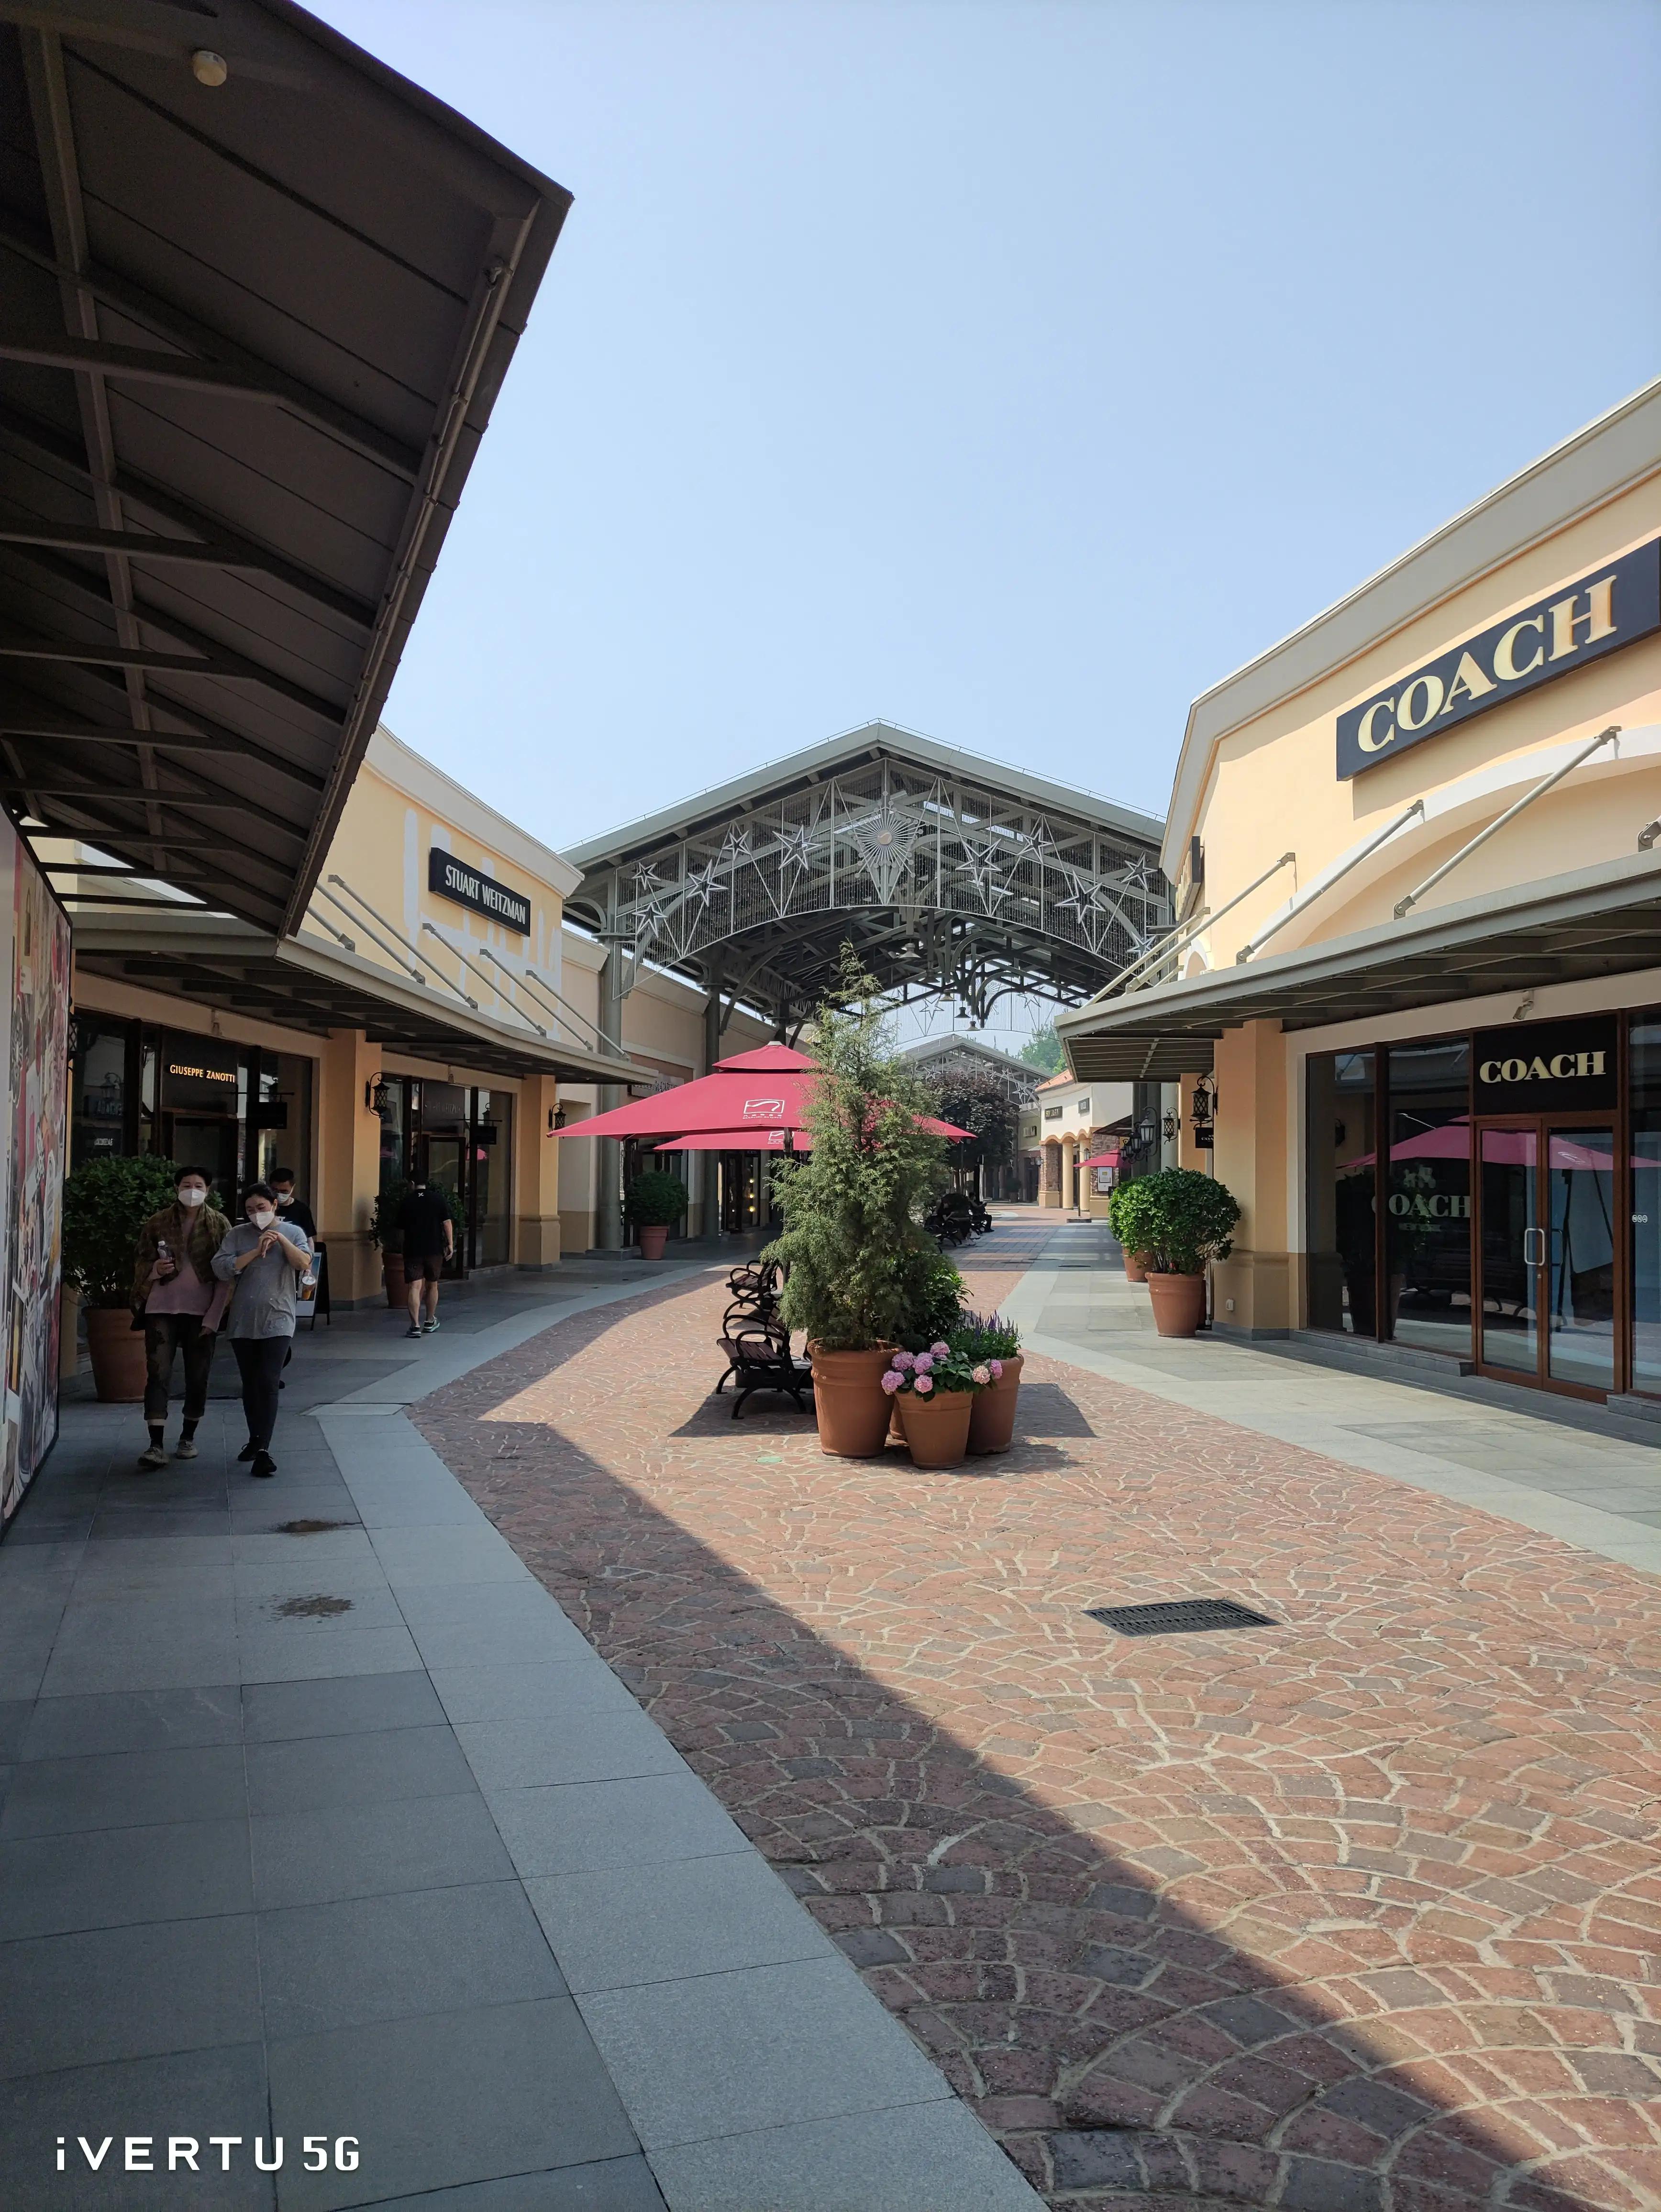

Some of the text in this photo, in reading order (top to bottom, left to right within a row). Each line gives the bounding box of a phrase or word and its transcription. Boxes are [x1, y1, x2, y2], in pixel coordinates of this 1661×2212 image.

[1357, 575, 1617, 752] COACH
[445, 864, 526, 925] STUART WEITZMAN
[169, 1064, 235, 1083] GIUSEPPE ZANOTTI
[1479, 1051, 1607, 1084] COACH
[1371, 1194, 1470, 1218] OACH
